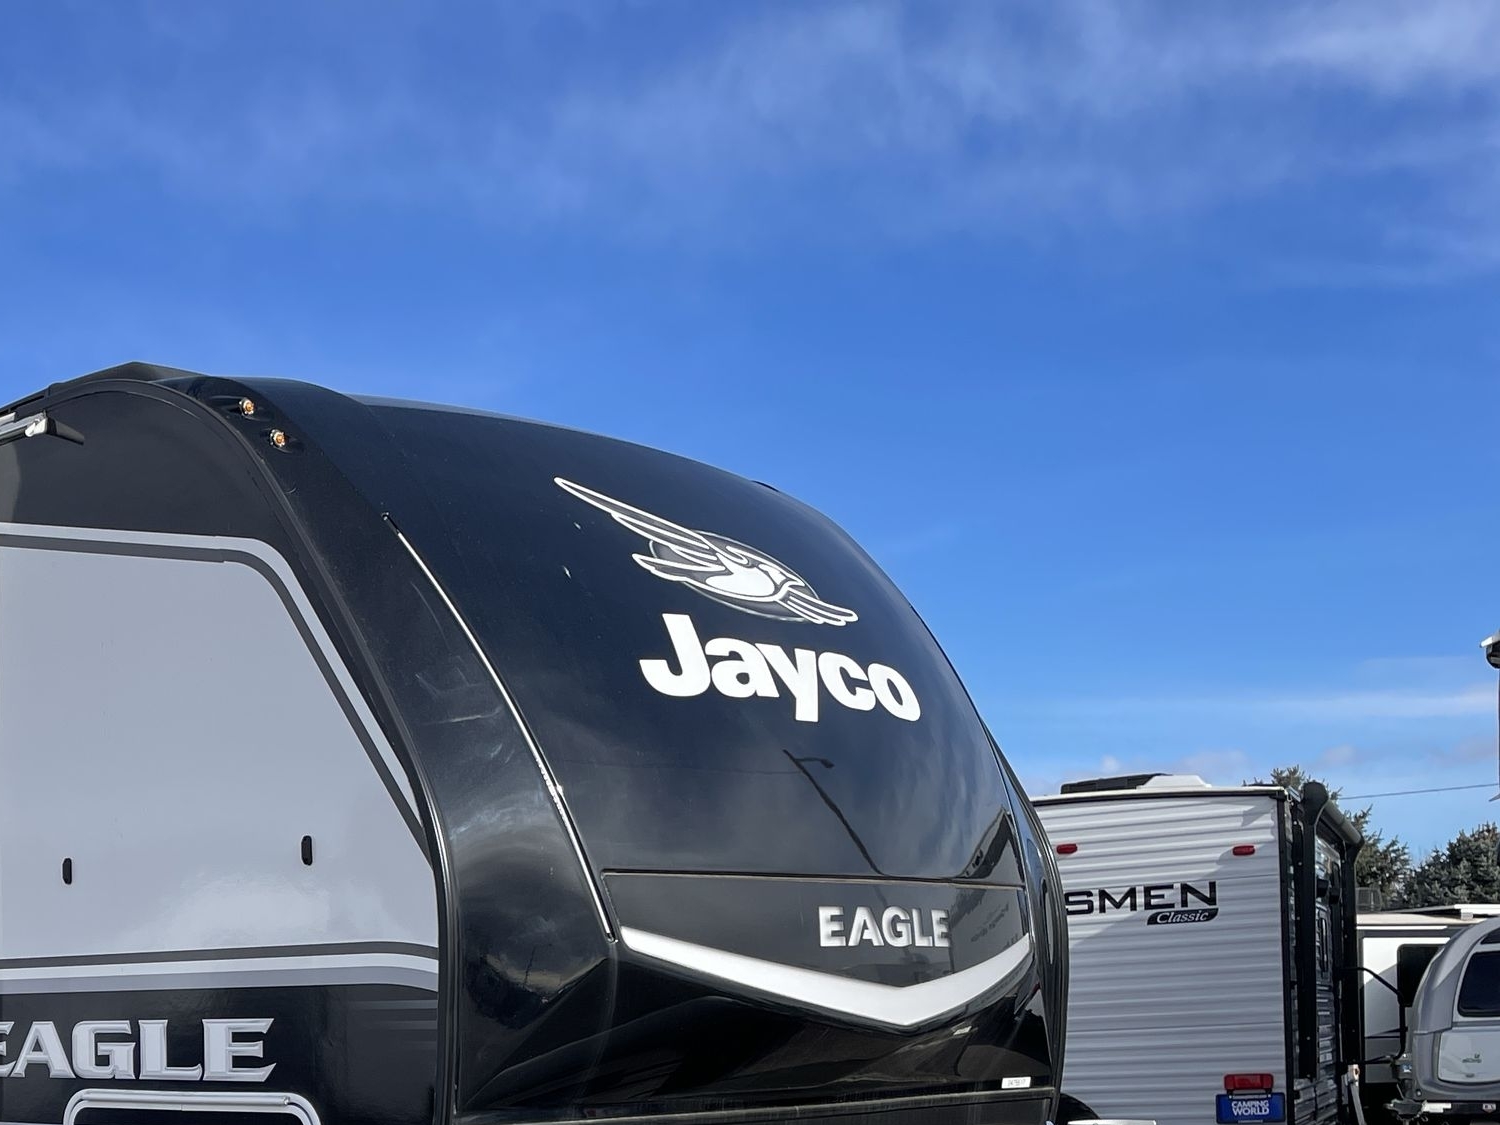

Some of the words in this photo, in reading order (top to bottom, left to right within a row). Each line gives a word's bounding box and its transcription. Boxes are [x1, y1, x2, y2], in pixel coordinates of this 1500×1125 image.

[639, 613, 921, 722] Jayco
[1156, 910, 1209, 924] Classic
[818, 906, 950, 947] EAGLE
[1231, 1100, 1269, 1109] CAMPING
[1232, 1107, 1270, 1116] WORLD
